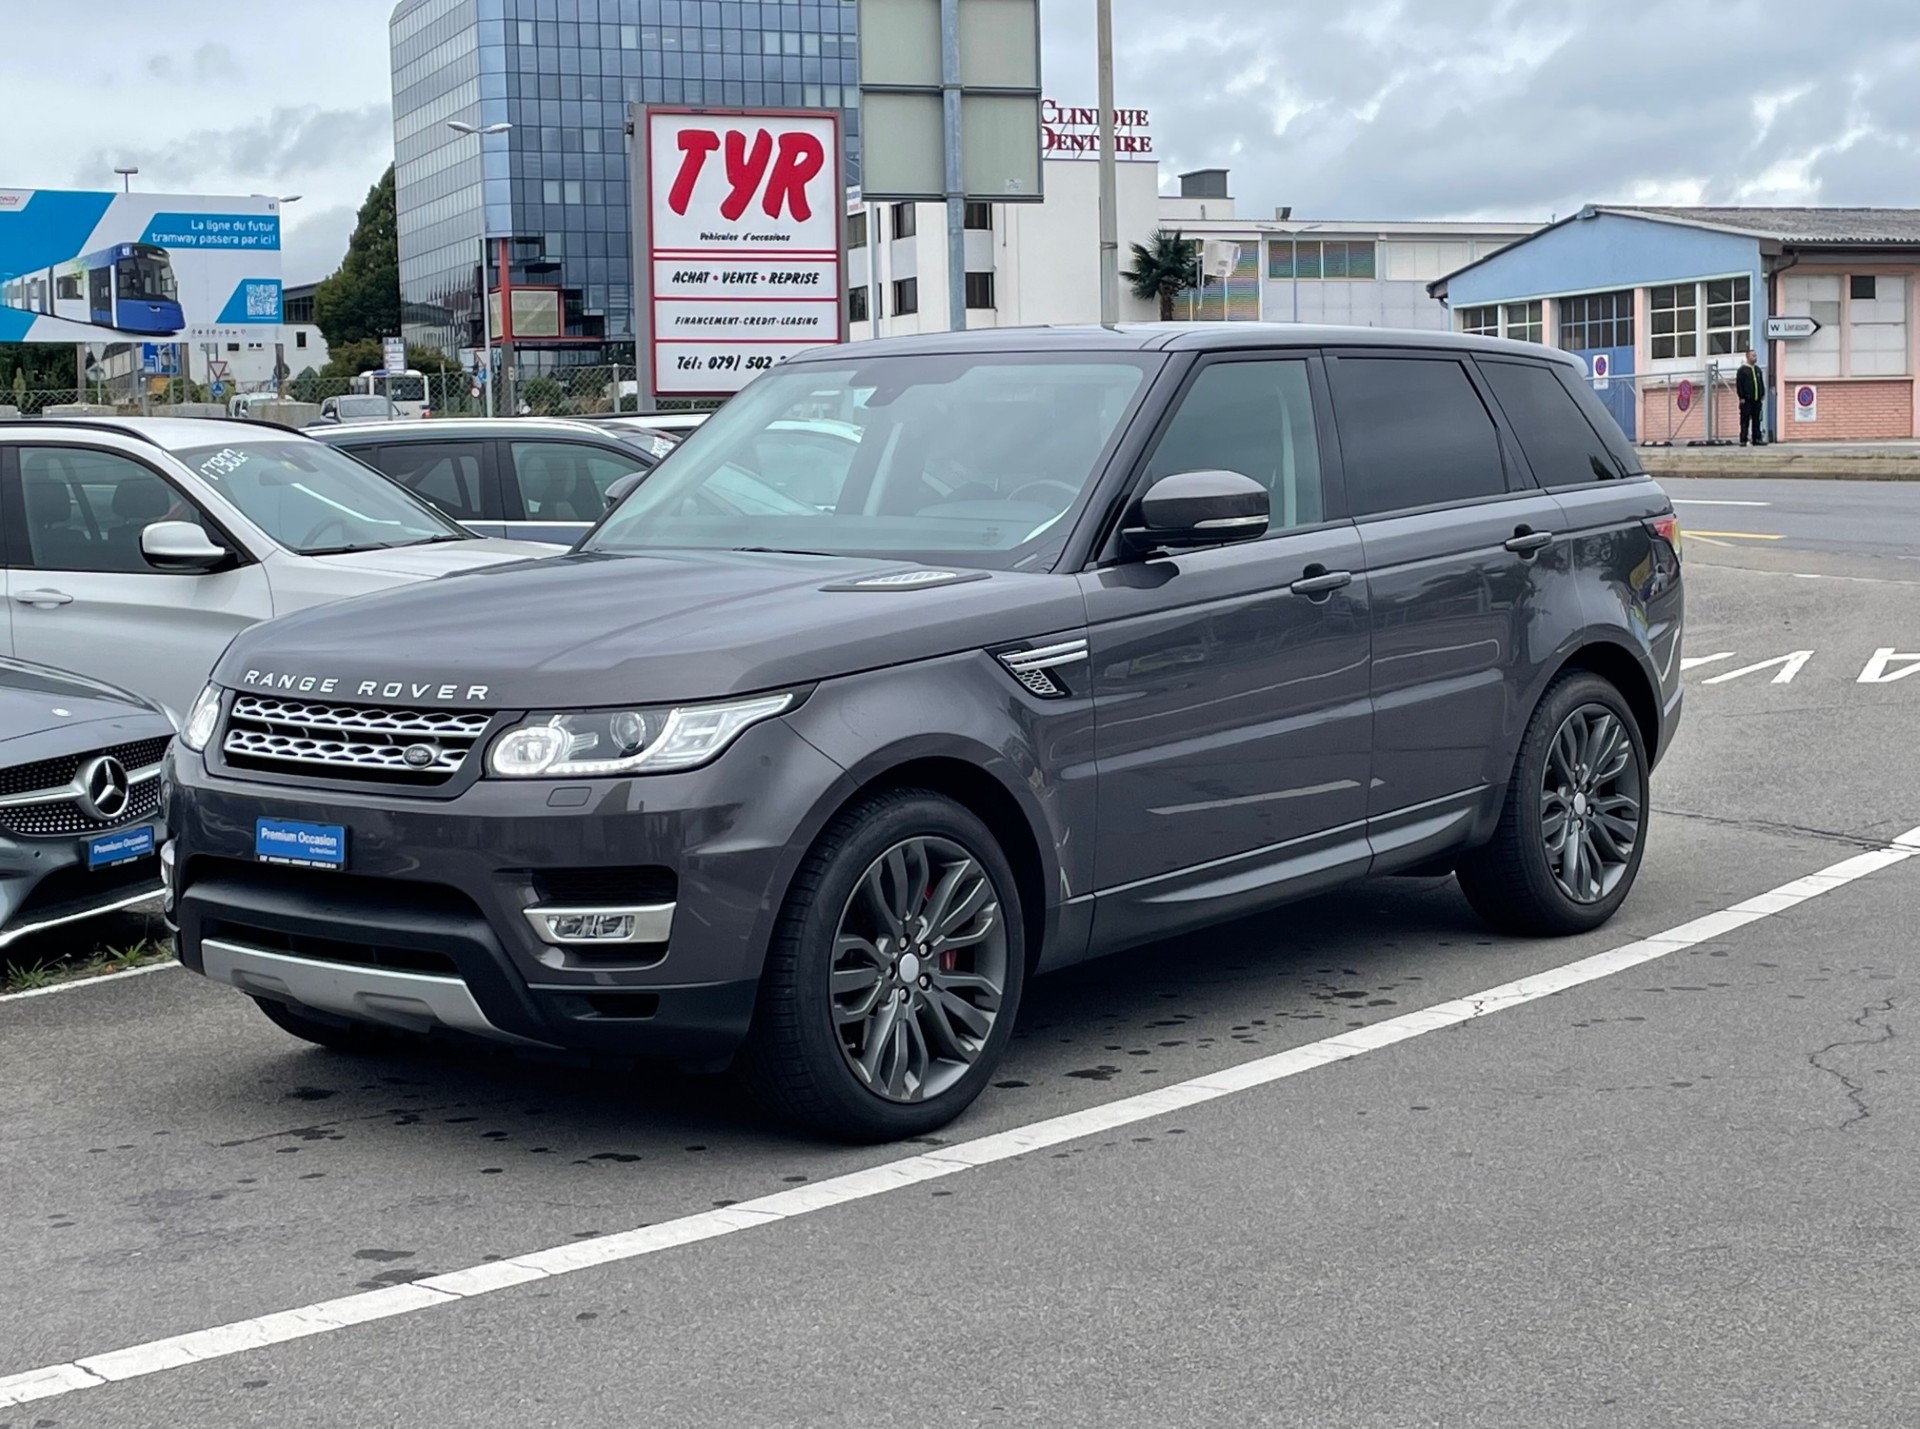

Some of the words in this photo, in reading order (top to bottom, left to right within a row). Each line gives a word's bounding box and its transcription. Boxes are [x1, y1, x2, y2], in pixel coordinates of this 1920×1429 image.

[1041, 99, 1149, 129] CLINUE
[1041, 126, 1152, 152] DENTIRE
[668, 128, 825, 223] TYR
[191, 219, 204, 230] La
[206, 220, 231, 233] ligne
[233, 221, 246, 231] du
[248, 220, 275, 232] futur
[152, 232, 198, 246] tramway
[199, 234, 239, 246] passera
[241, 235, 258, 247] par
[672, 271, 711, 284] ACHAT
[721, 271, 760, 284] VENTE
[768, 272, 820, 284] REPRISE
[677, 355, 703, 370] Tél:
[745, 355, 773, 370] 502
[244, 669, 339, 693] RANGE
[357, 681, 489, 701] ROVER
[261, 827, 298, 843] Premium
[298, 831, 337, 847] Occasion
